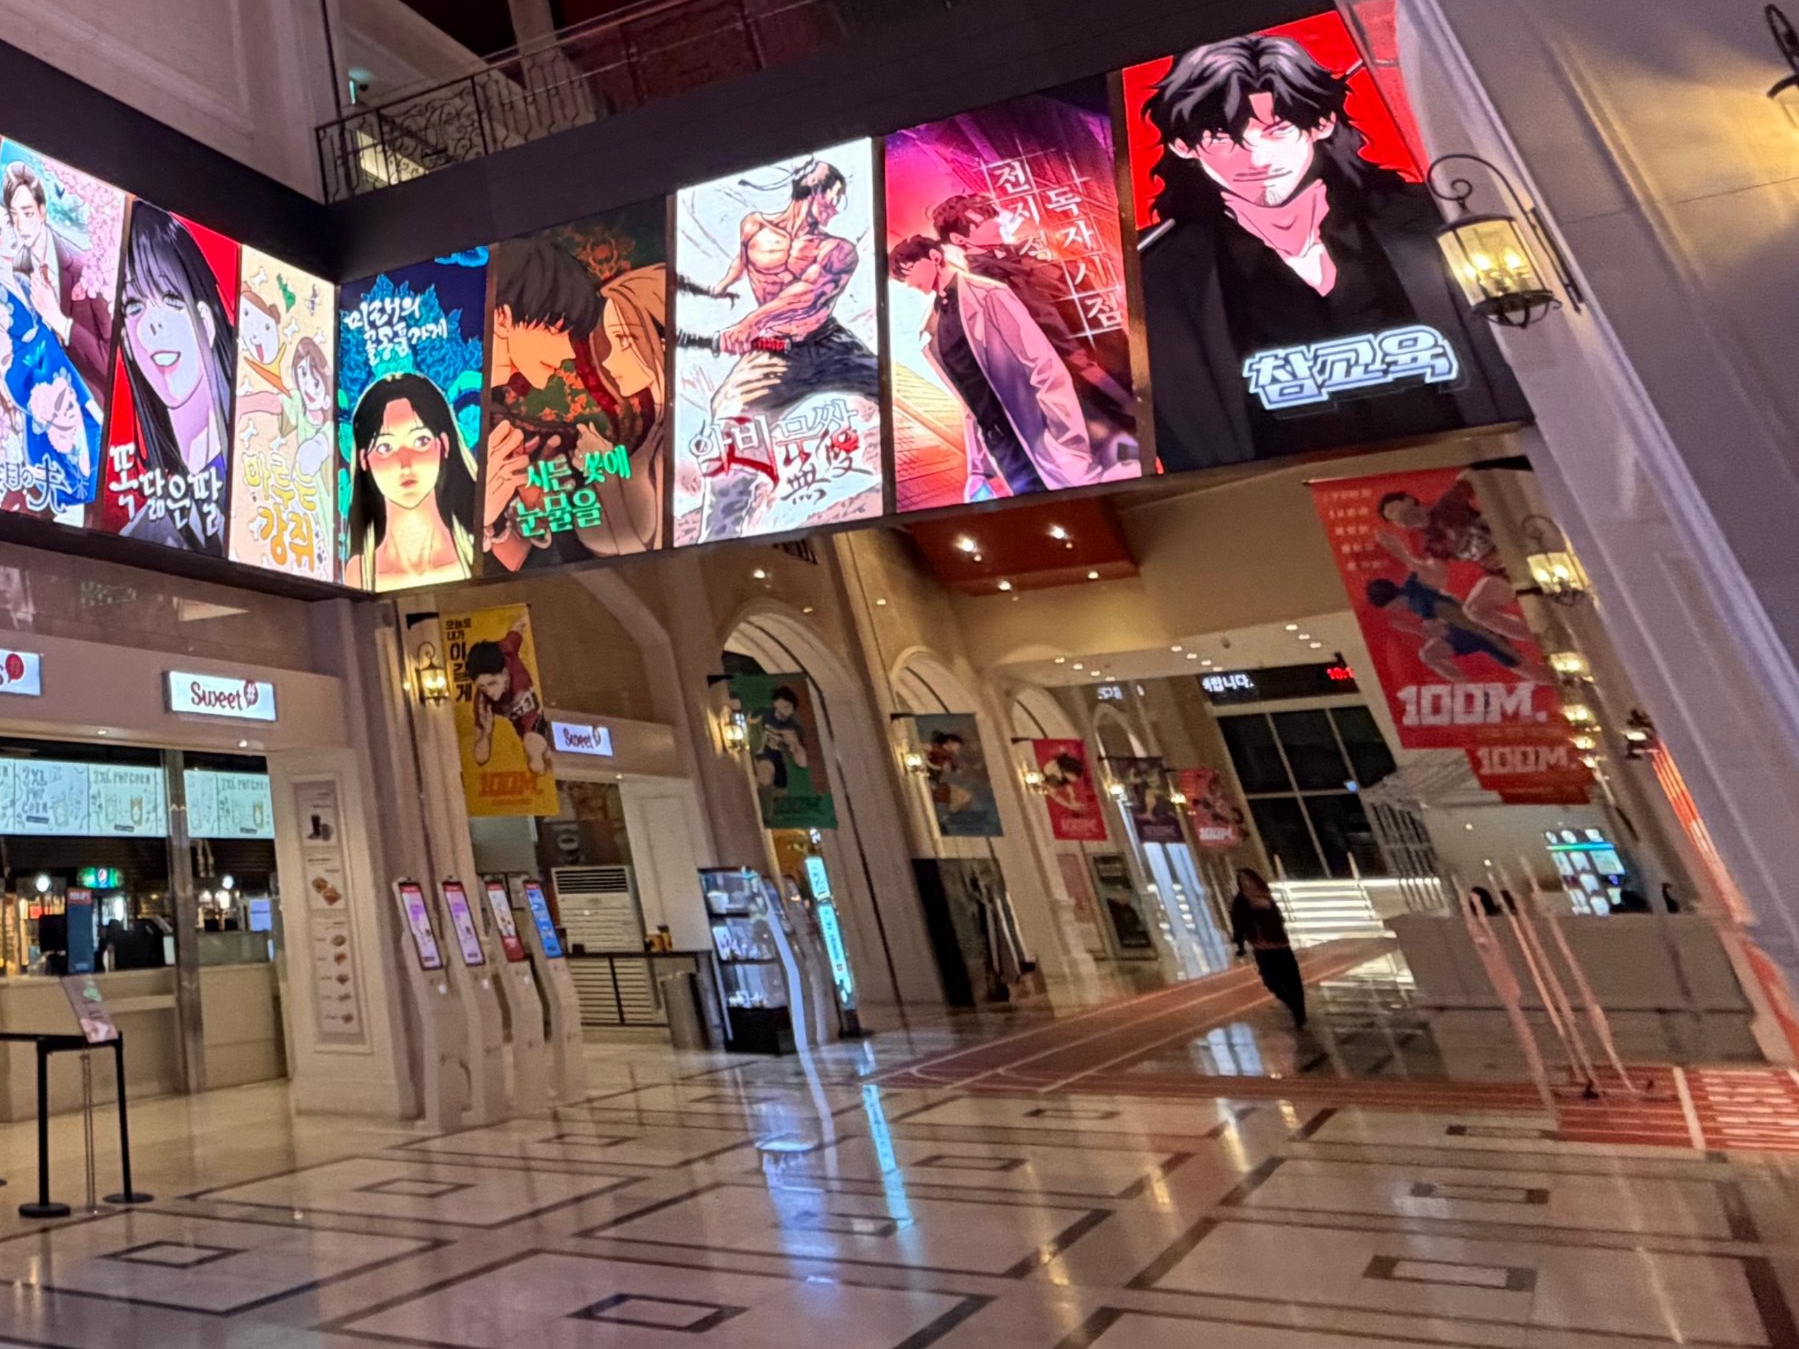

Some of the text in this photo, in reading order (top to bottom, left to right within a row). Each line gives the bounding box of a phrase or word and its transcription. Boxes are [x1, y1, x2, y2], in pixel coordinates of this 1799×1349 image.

[993, 160, 1053, 262] 전지적
[343, 294, 421, 332] 미래의
[1243, 326, 1459, 410] 참교육
[525, 444, 632, 493] 시든 꽃에
[516, 487, 602, 538] 눈물을
[255, 503, 316, 573] 강쥐
[190, 681, 245, 712] Sweet
[1396, 681, 1548, 726] 100M.
